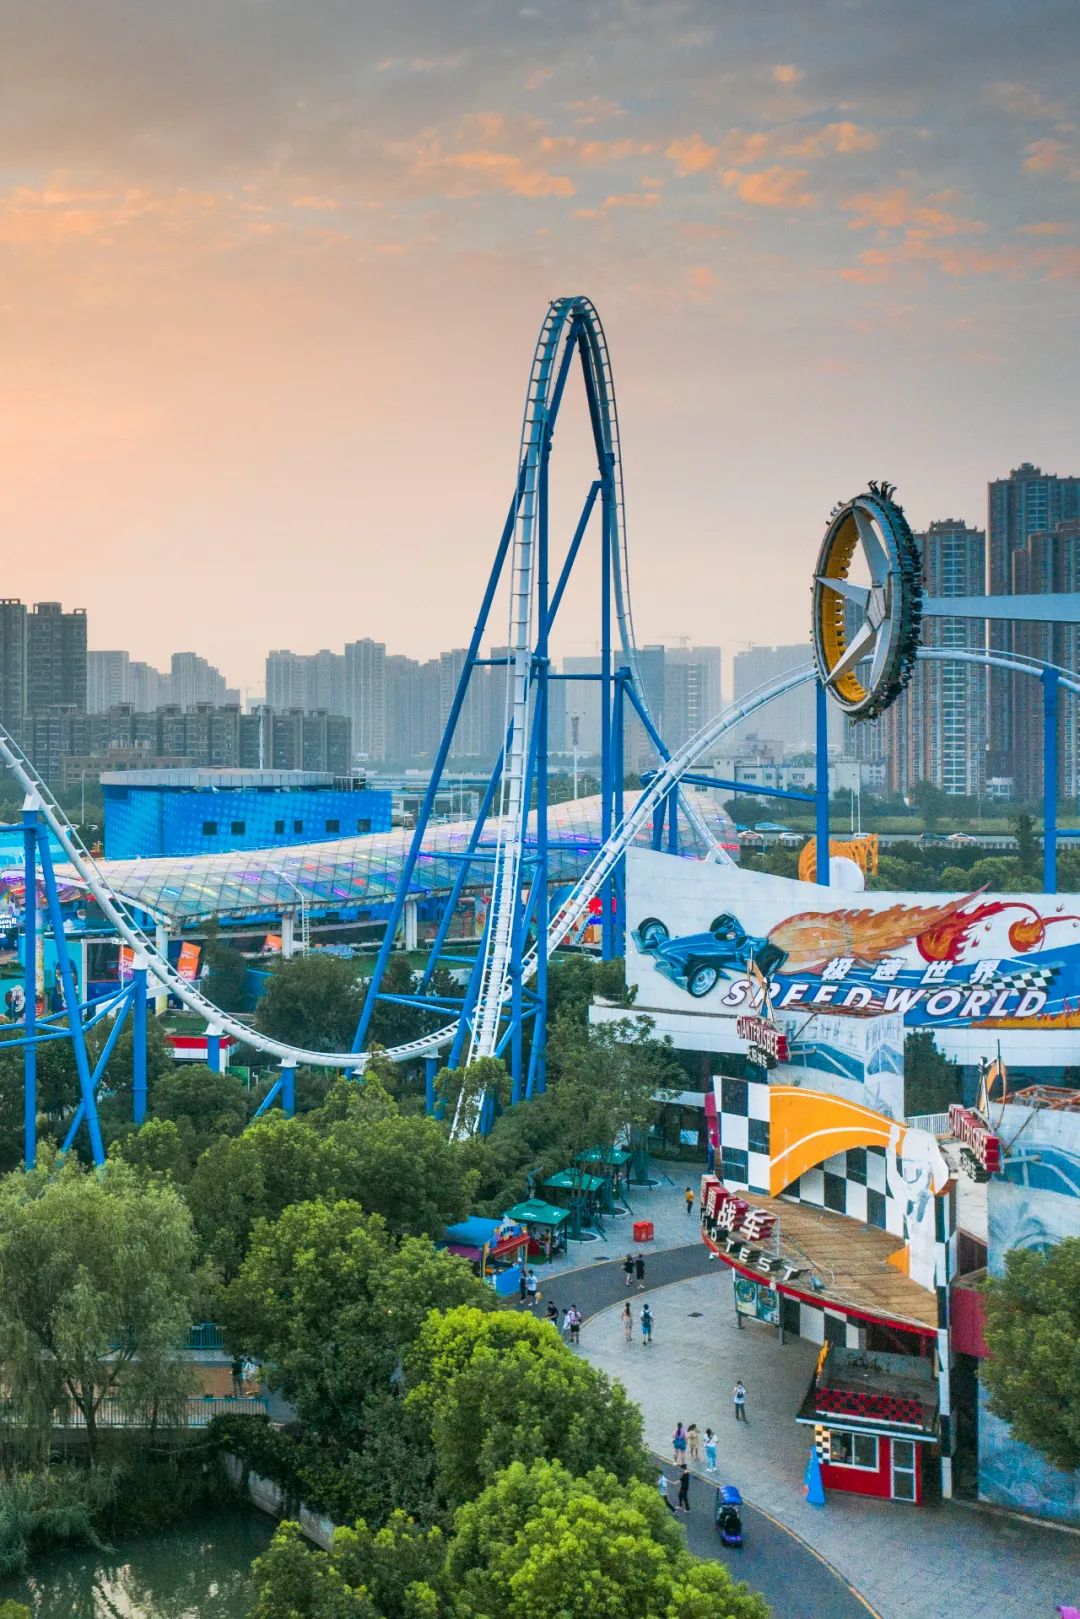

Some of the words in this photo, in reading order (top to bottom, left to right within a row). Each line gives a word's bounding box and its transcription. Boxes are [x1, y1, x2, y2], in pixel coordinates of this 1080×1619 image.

[821, 956, 1001, 985] 极速世界
[721, 979, 873, 1009] SPEED
[883, 987, 1049, 1018] WORLD
[726, 1238, 798, 1281] TEST
